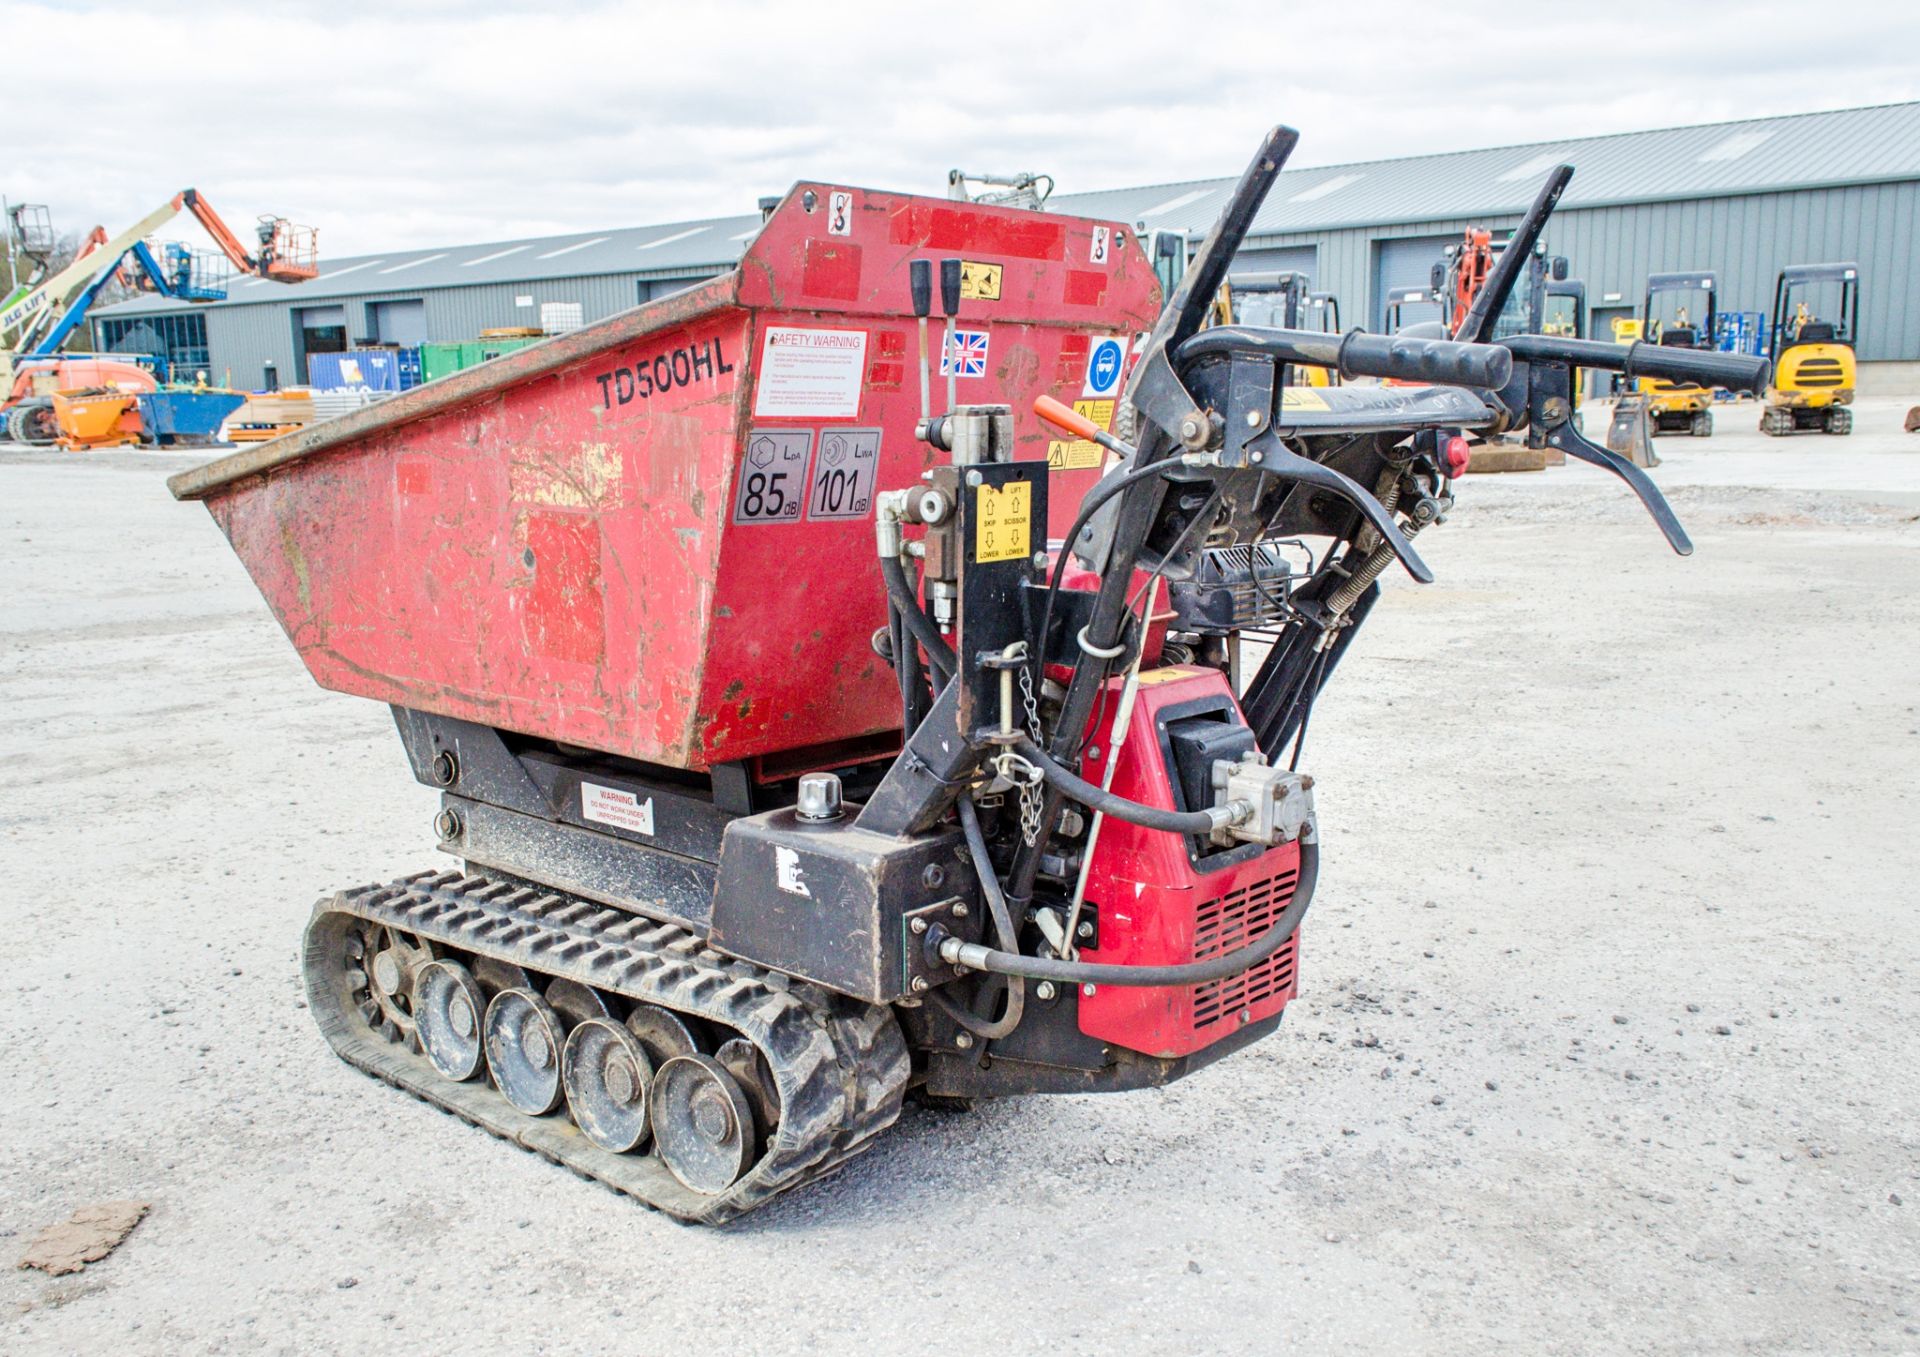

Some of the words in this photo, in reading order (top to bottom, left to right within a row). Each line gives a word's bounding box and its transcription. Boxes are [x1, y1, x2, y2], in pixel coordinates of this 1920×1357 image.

[4, 307, 22, 327] JLG
[24, 291, 47, 312] LIFT
[771, 332, 811, 346] SAFETY
[814, 335, 860, 348] WARNING
[596, 336, 733, 409] TD500HL
[743, 472, 787, 517] 85
[1004, 517, 1026, 525] SCISSOR
[980, 551, 999, 559] LOWER
[1005, 548, 1024, 556] LOWER
[600, 791, 633, 805] WARNING
[599, 802, 609, 810] NOT
[610, 805, 626, 814] WORK
[626, 808, 644, 819] UNDER
